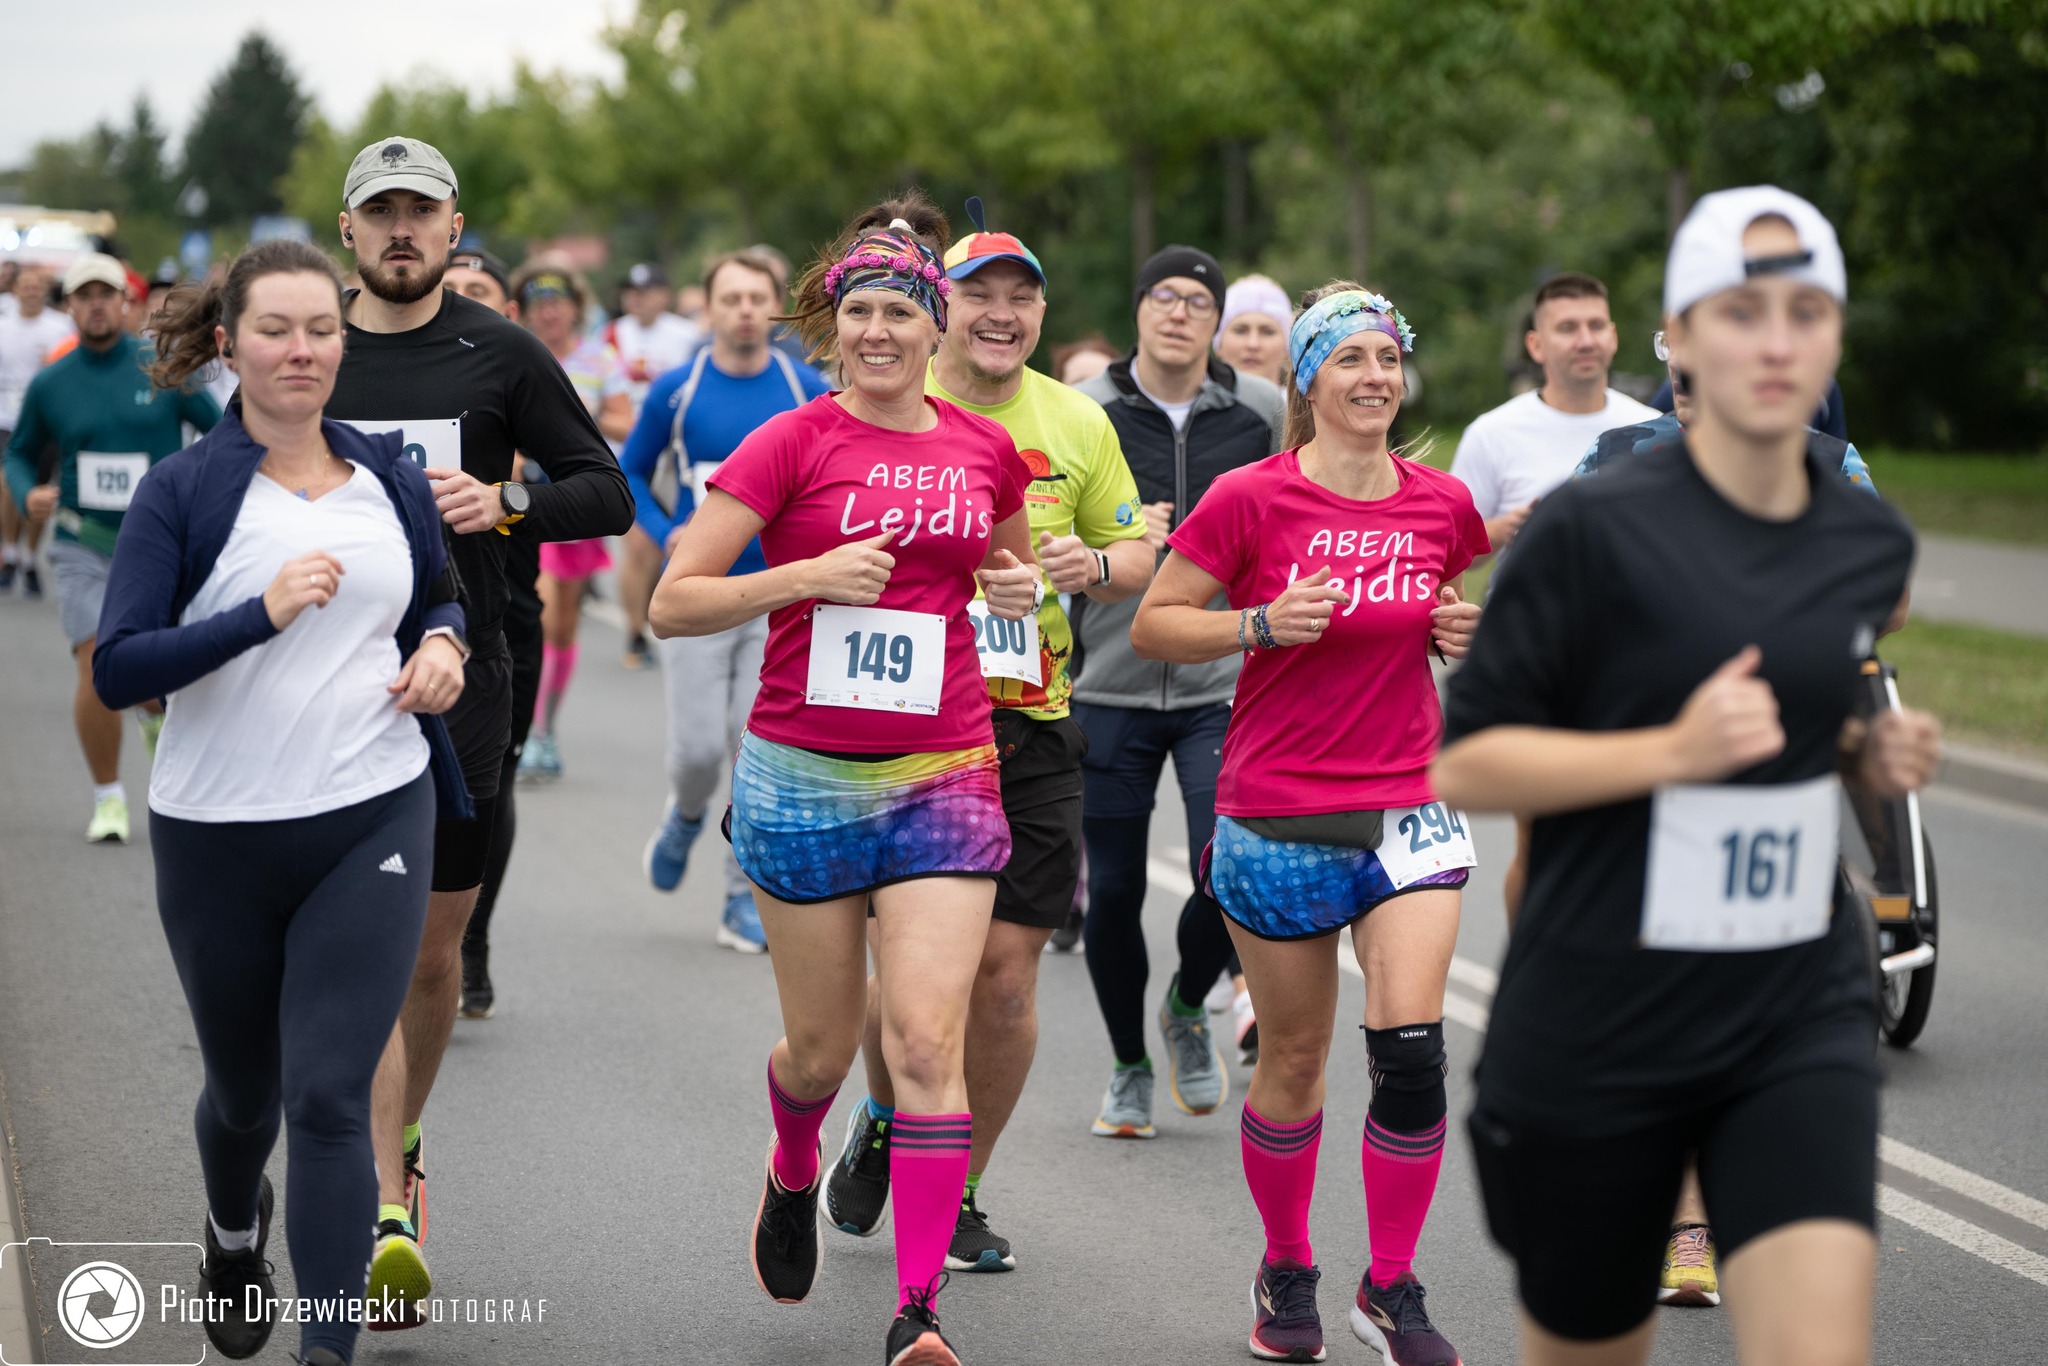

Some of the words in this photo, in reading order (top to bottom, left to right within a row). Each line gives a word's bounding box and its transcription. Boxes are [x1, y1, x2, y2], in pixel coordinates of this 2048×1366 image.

[96, 467, 131, 494] 120
[866, 463, 967, 491] ABEM
[840, 492, 988, 547] Lejdis
[1307, 529, 1414, 557] ABEM
[969, 614, 1026, 656] 200
[844, 630, 913, 683] 149
[1398, 801, 1466, 854] 294
[1719, 825, 1802, 902] 161
[1399, 1030, 1428, 1039] TARMAK
